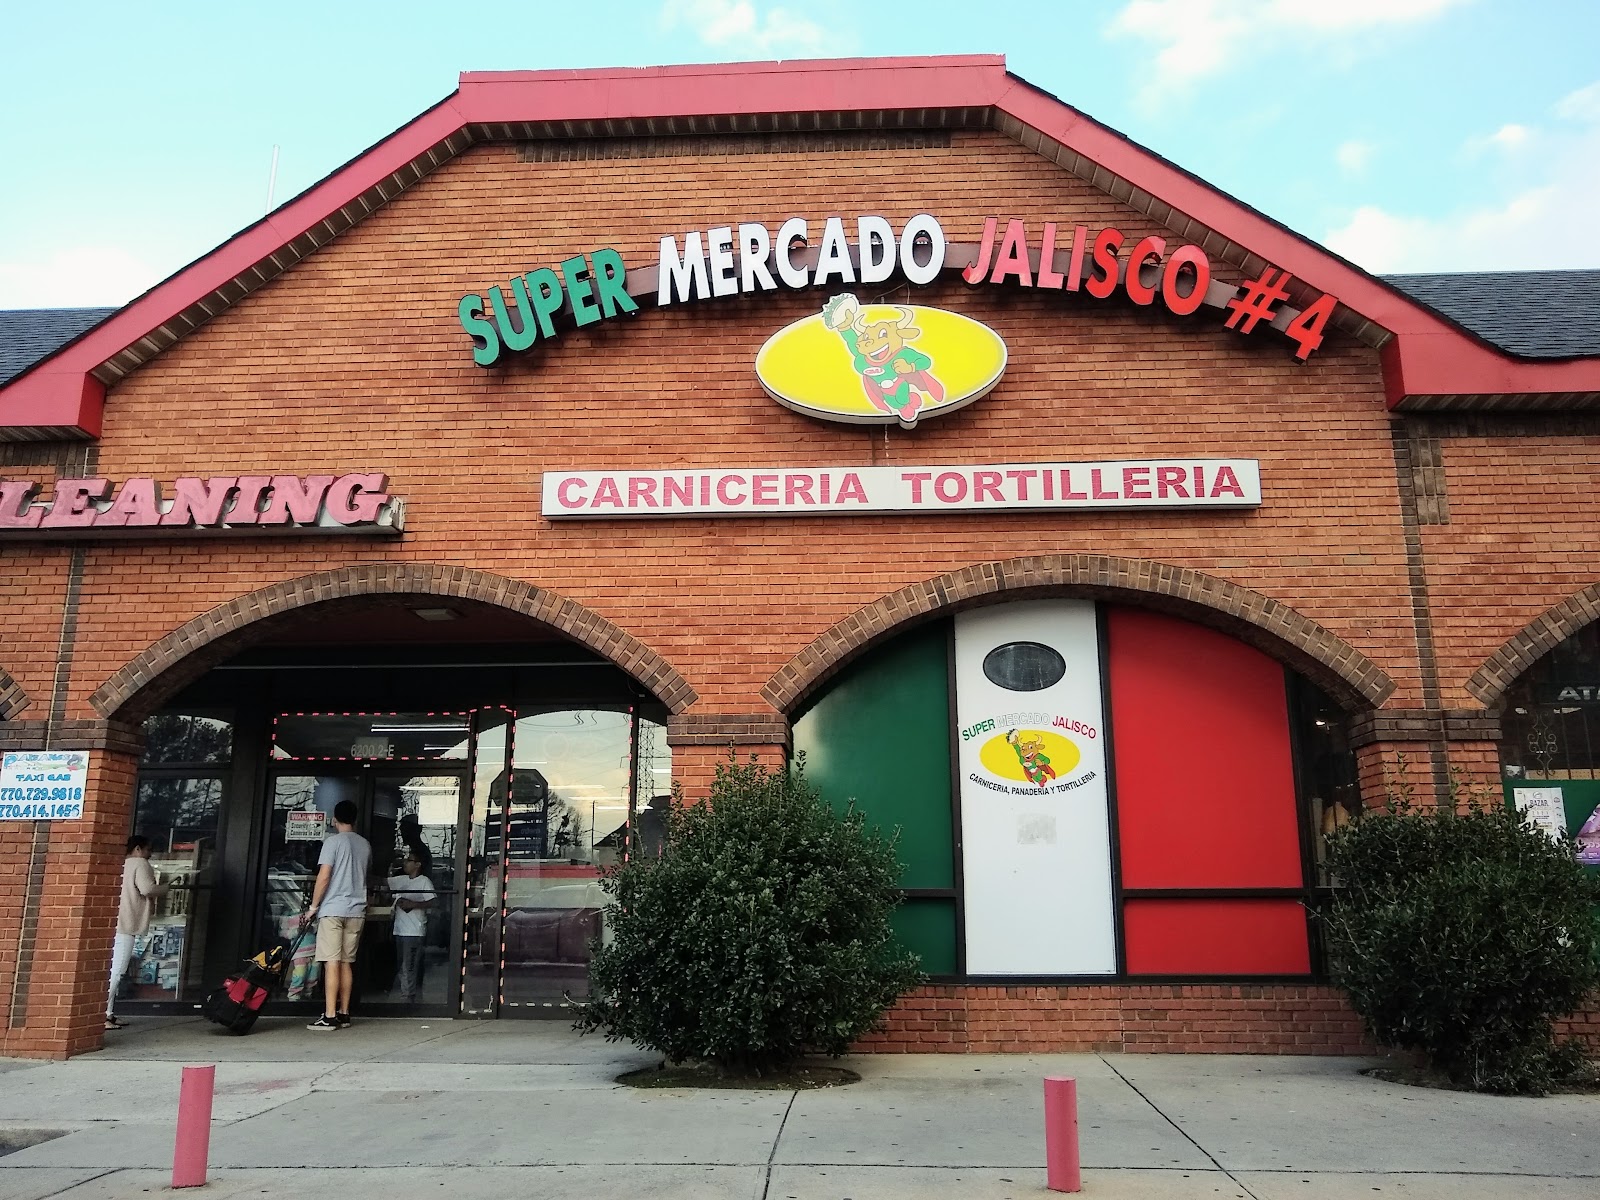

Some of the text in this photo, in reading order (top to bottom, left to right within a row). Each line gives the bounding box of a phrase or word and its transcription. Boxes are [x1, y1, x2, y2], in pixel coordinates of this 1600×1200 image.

[458, 213, 1338, 366] SUPER MERCADO JALISCO #4
[557, 466, 1245, 509] CARNICERIA TORTILLERIA
[962, 712, 1097, 741] SUPER MERCADO JALISCO
[16, 773, 45, 782] TAXI
[969, 773, 1010, 795] CARNICERIA,
[1050, 786, 1055, 794] Y
[1, 787, 82, 801] 770.729.9818
[291, 813, 323, 821] WARNING
